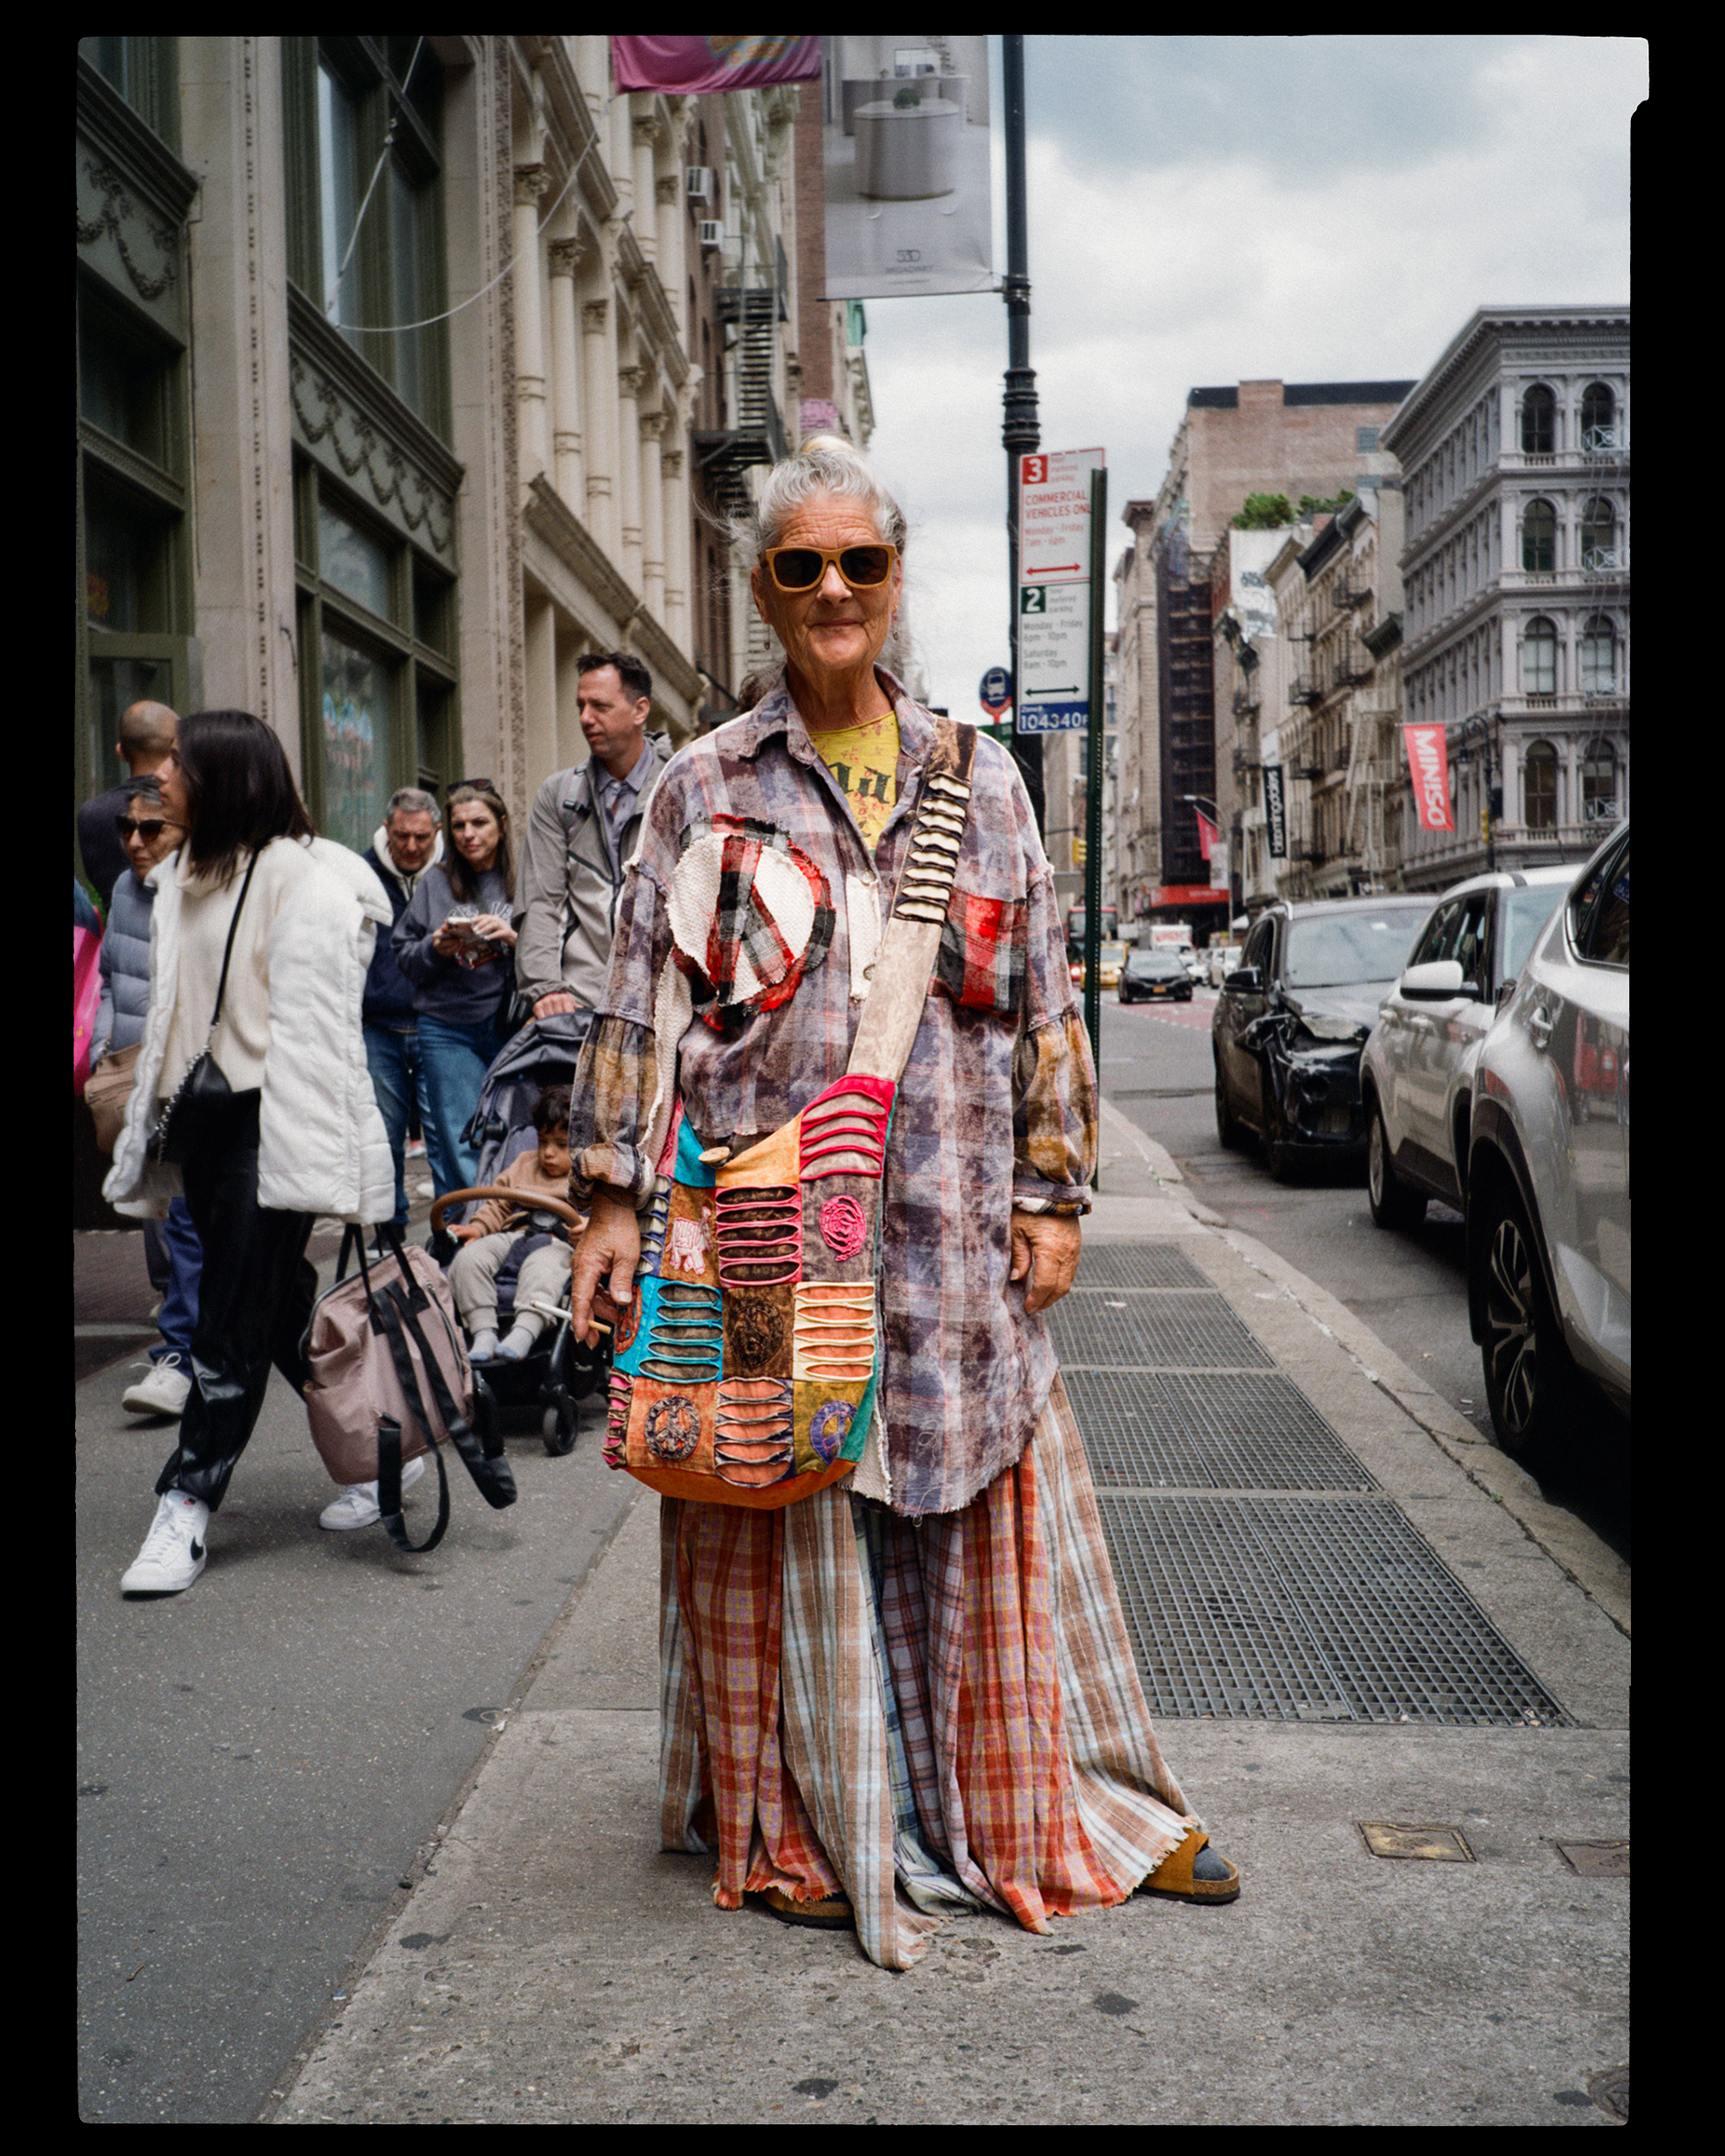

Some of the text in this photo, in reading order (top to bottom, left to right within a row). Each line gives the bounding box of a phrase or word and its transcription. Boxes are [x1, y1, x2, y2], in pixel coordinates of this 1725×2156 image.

[1027, 457, 1043, 483] 3
[1025, 490, 1088, 506] COMMERCIAL
[1025, 503, 1091, 519] VEHICLES ONL
[1025, 526, 1054, 535] Monday
[1026, 588, 1040, 612] 2
[1024, 649, 1057, 658] Saturday
[1414, 730, 1446, 826] MINISO
